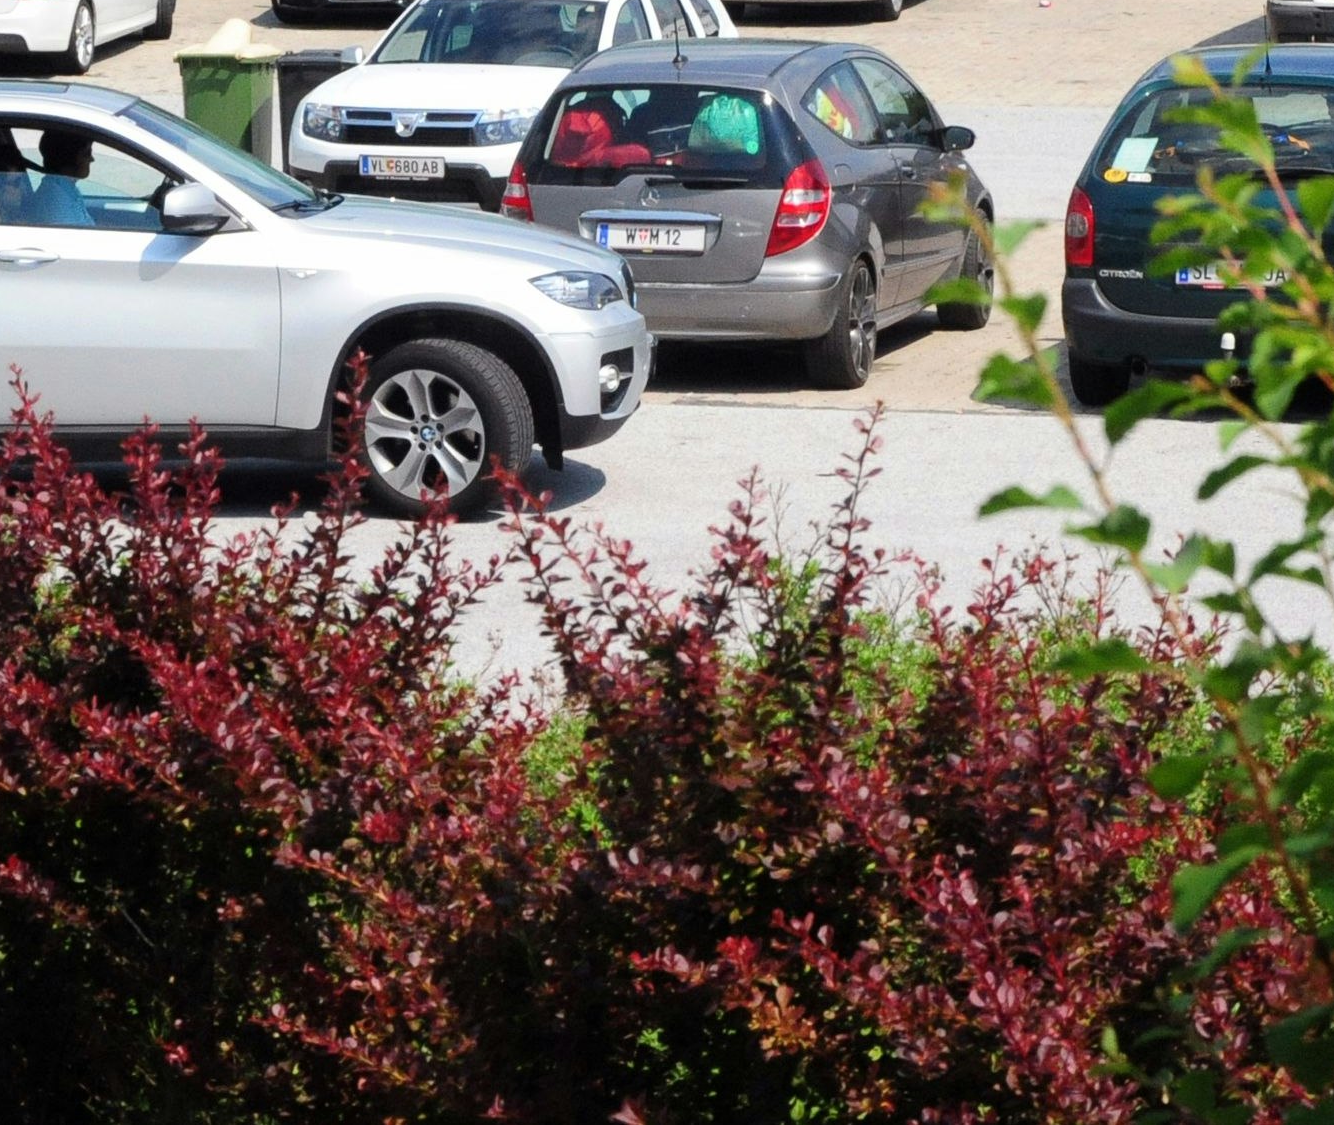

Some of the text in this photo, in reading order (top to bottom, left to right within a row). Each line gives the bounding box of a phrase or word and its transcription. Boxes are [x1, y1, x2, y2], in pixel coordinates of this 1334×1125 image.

[371, 159, 439, 174] VL 680 AB
[626, 228, 681, 246] W M 12
